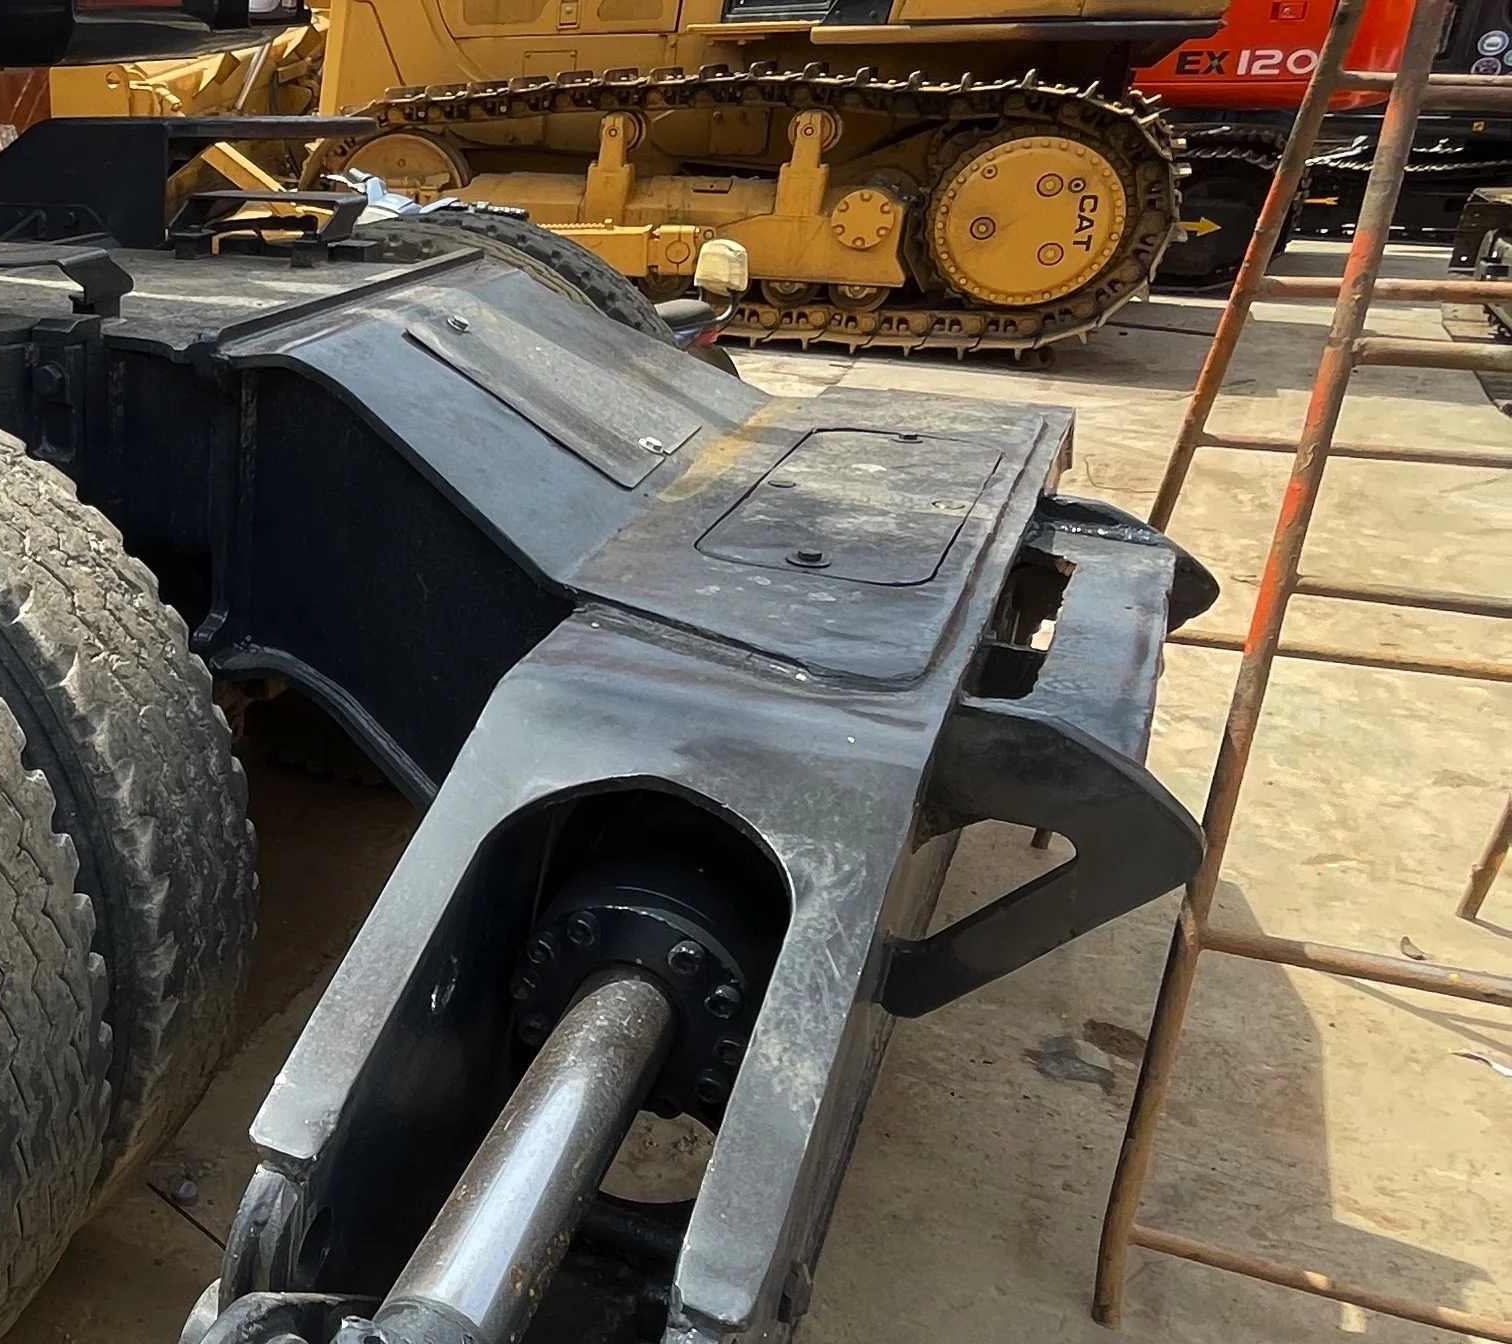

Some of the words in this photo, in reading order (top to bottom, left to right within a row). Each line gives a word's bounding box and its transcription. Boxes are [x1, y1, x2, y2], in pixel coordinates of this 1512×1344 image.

[1175, 50, 1231, 75] EX
[1236, 48, 1320, 75] 120
[1072, 194, 1099, 252] CAT
